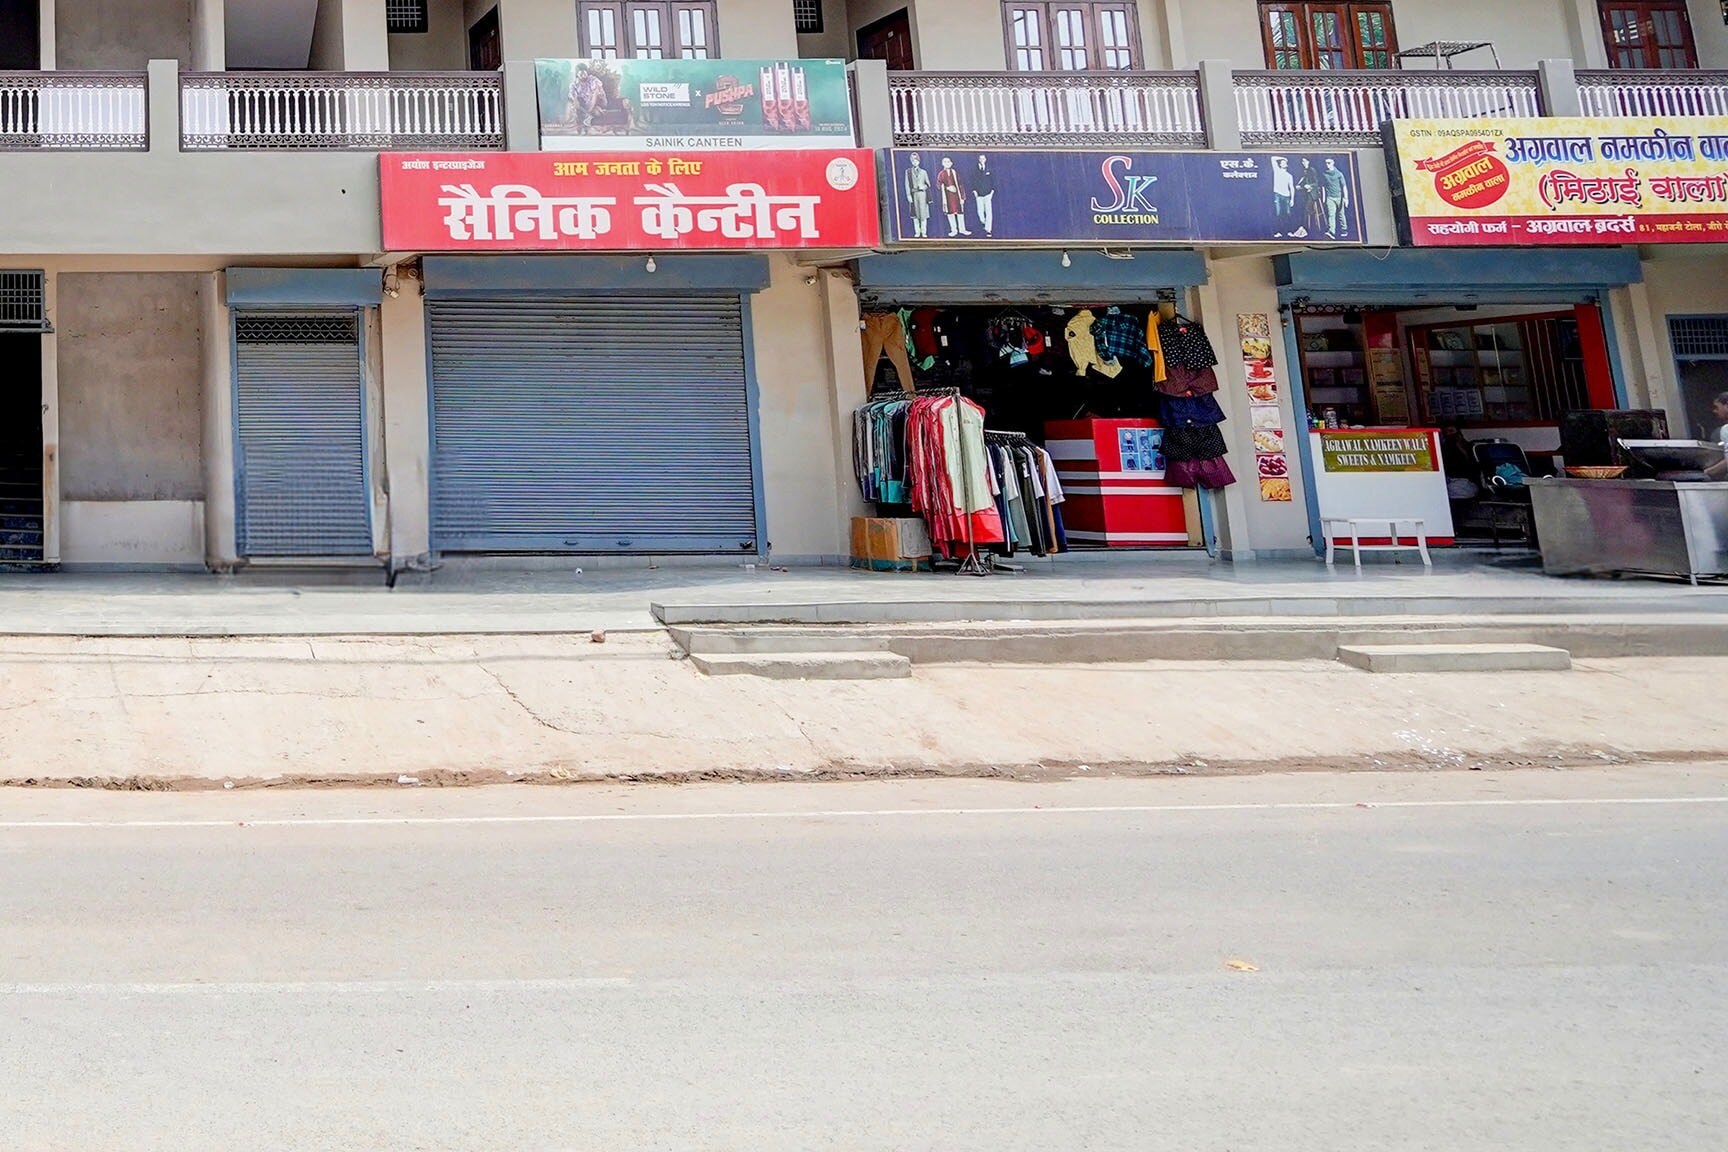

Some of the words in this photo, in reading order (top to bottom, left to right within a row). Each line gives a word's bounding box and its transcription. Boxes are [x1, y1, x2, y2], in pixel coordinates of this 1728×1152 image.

[705, 83, 754, 109] PUSHPA
[646, 137, 684, 147] SAINIK
[687, 137, 742, 147] CANTEEN
[1410, 129, 1432, 137] GSTIN
[1504, 136, 1594, 166] अग्रवाल
[1598, 128, 1695, 161] नमकीन
[553, 161, 588, 176] आम
[593, 161, 640, 176] जनता
[645, 159, 662, 175] के
[668, 158, 703, 175] लिए
[1440, 156, 1494, 191] अग्रवाल
[1091, 156, 1158, 213] SK
[1484, 174, 1506, 189] वाला
[1538, 168, 1642, 208] (मिठाई
[438, 183, 616, 241] सैनिक
[633, 183, 821, 240] कैन्टीन
[1093, 214, 1160, 225] COLLECTION
[1428, 221, 1480, 234] सहयोगी
[1481, 221, 1508, 234] फर्म
[1593, 215, 1637, 233] ब्रदर्स
[1325, 439, 1363, 452] AGRAWAL
[1363, 439, 1403, 451] NAMKEEN
[1403, 438, 1427, 451] WALA
[1337, 454, 1369, 466] SWEETS
[1378, 453, 1417, 465] NAMKEEN
